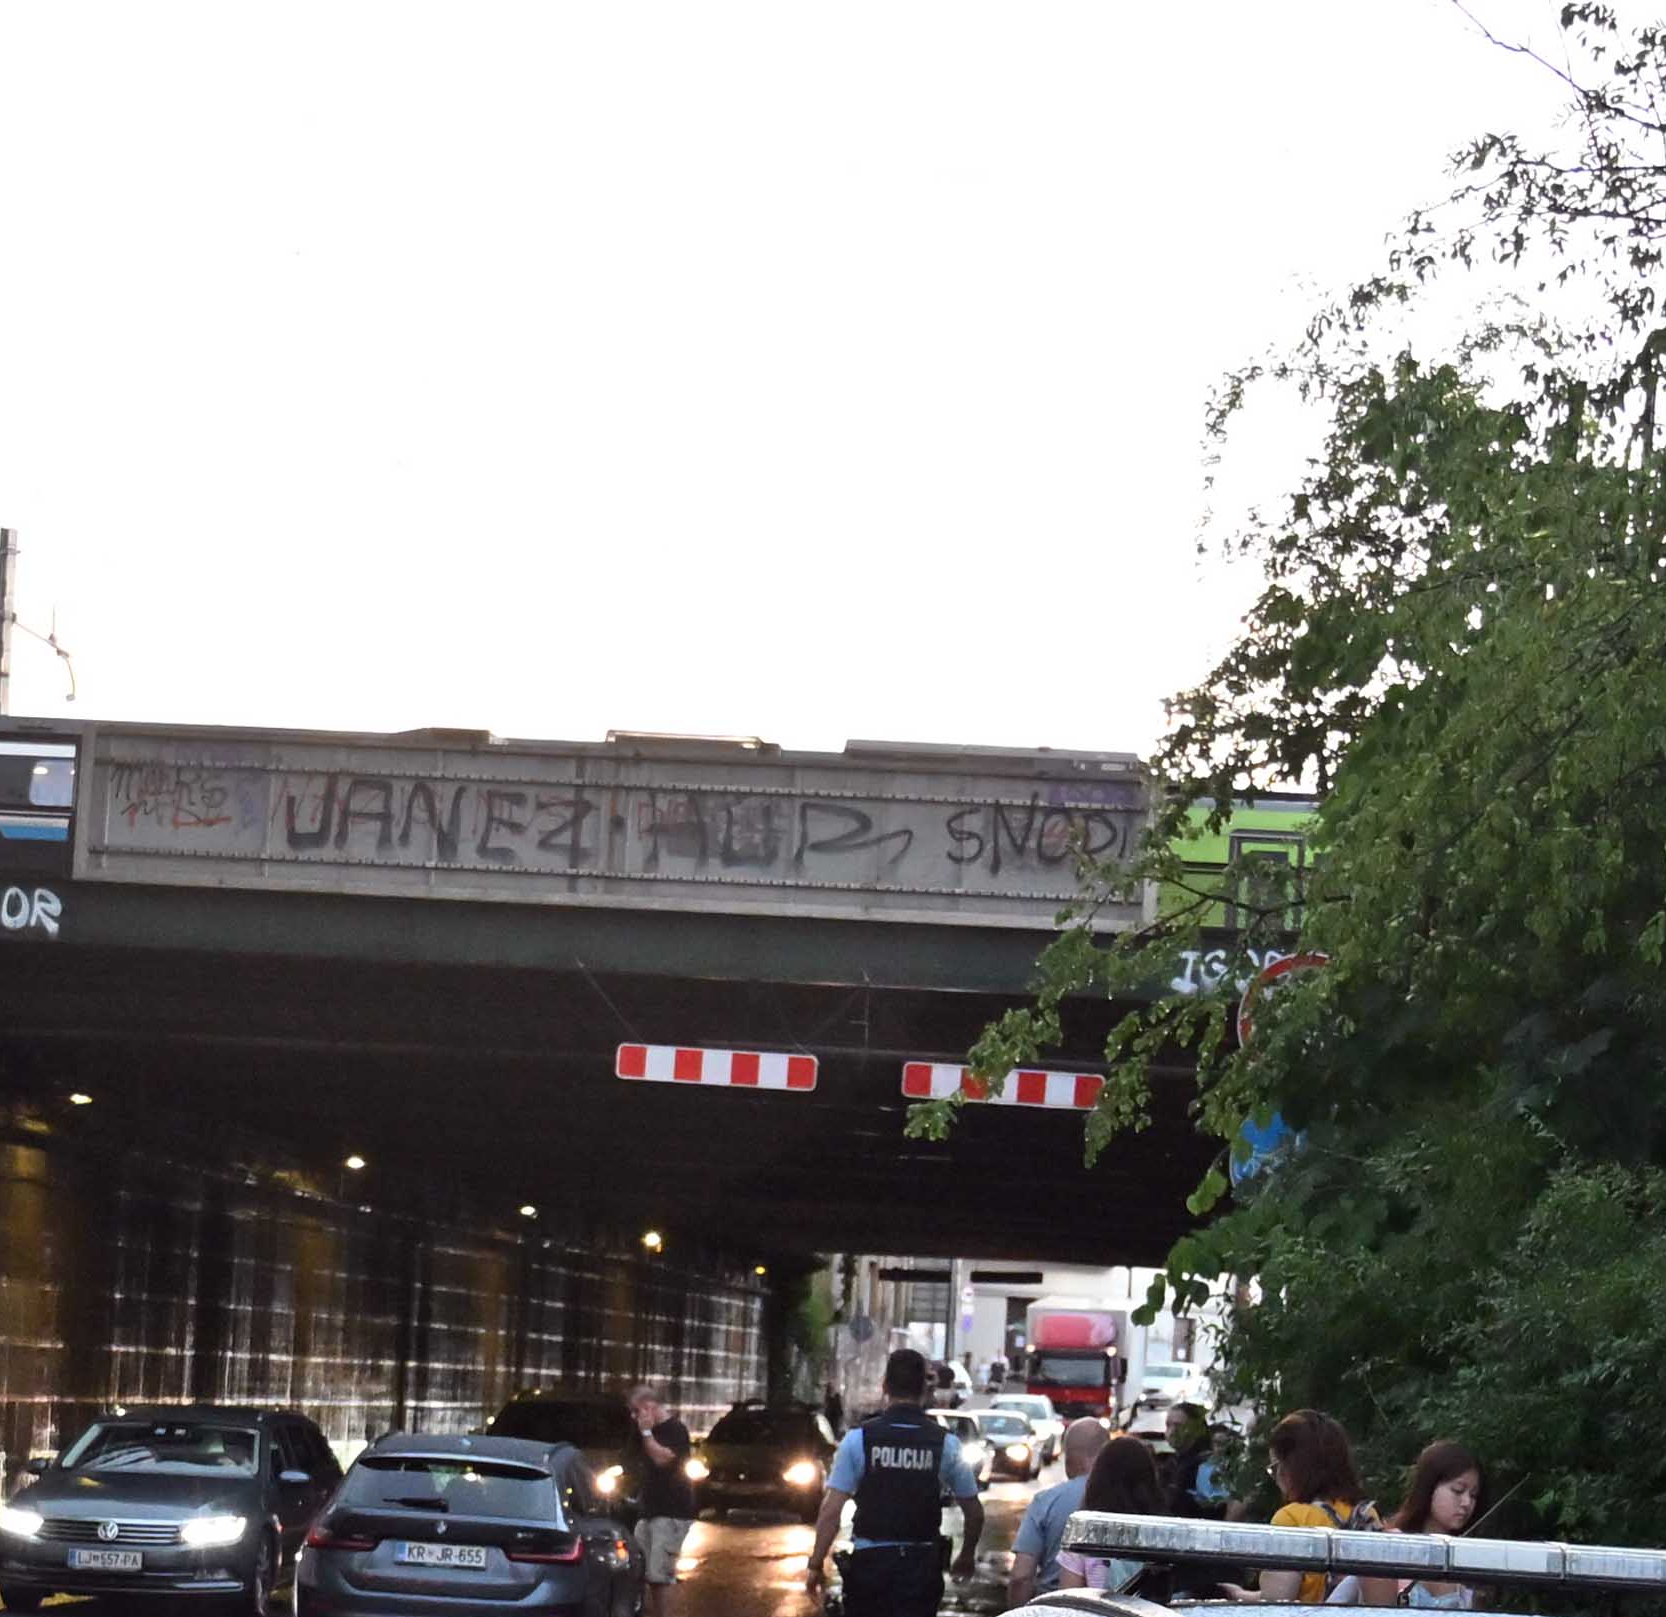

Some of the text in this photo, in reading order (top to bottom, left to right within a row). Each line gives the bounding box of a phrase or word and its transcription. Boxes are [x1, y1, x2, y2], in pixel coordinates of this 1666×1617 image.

[871, 1446, 934, 1471] POLICIJA
[77, 1551, 93, 1565] LJ
[407, 1545, 426, 1559] KR
